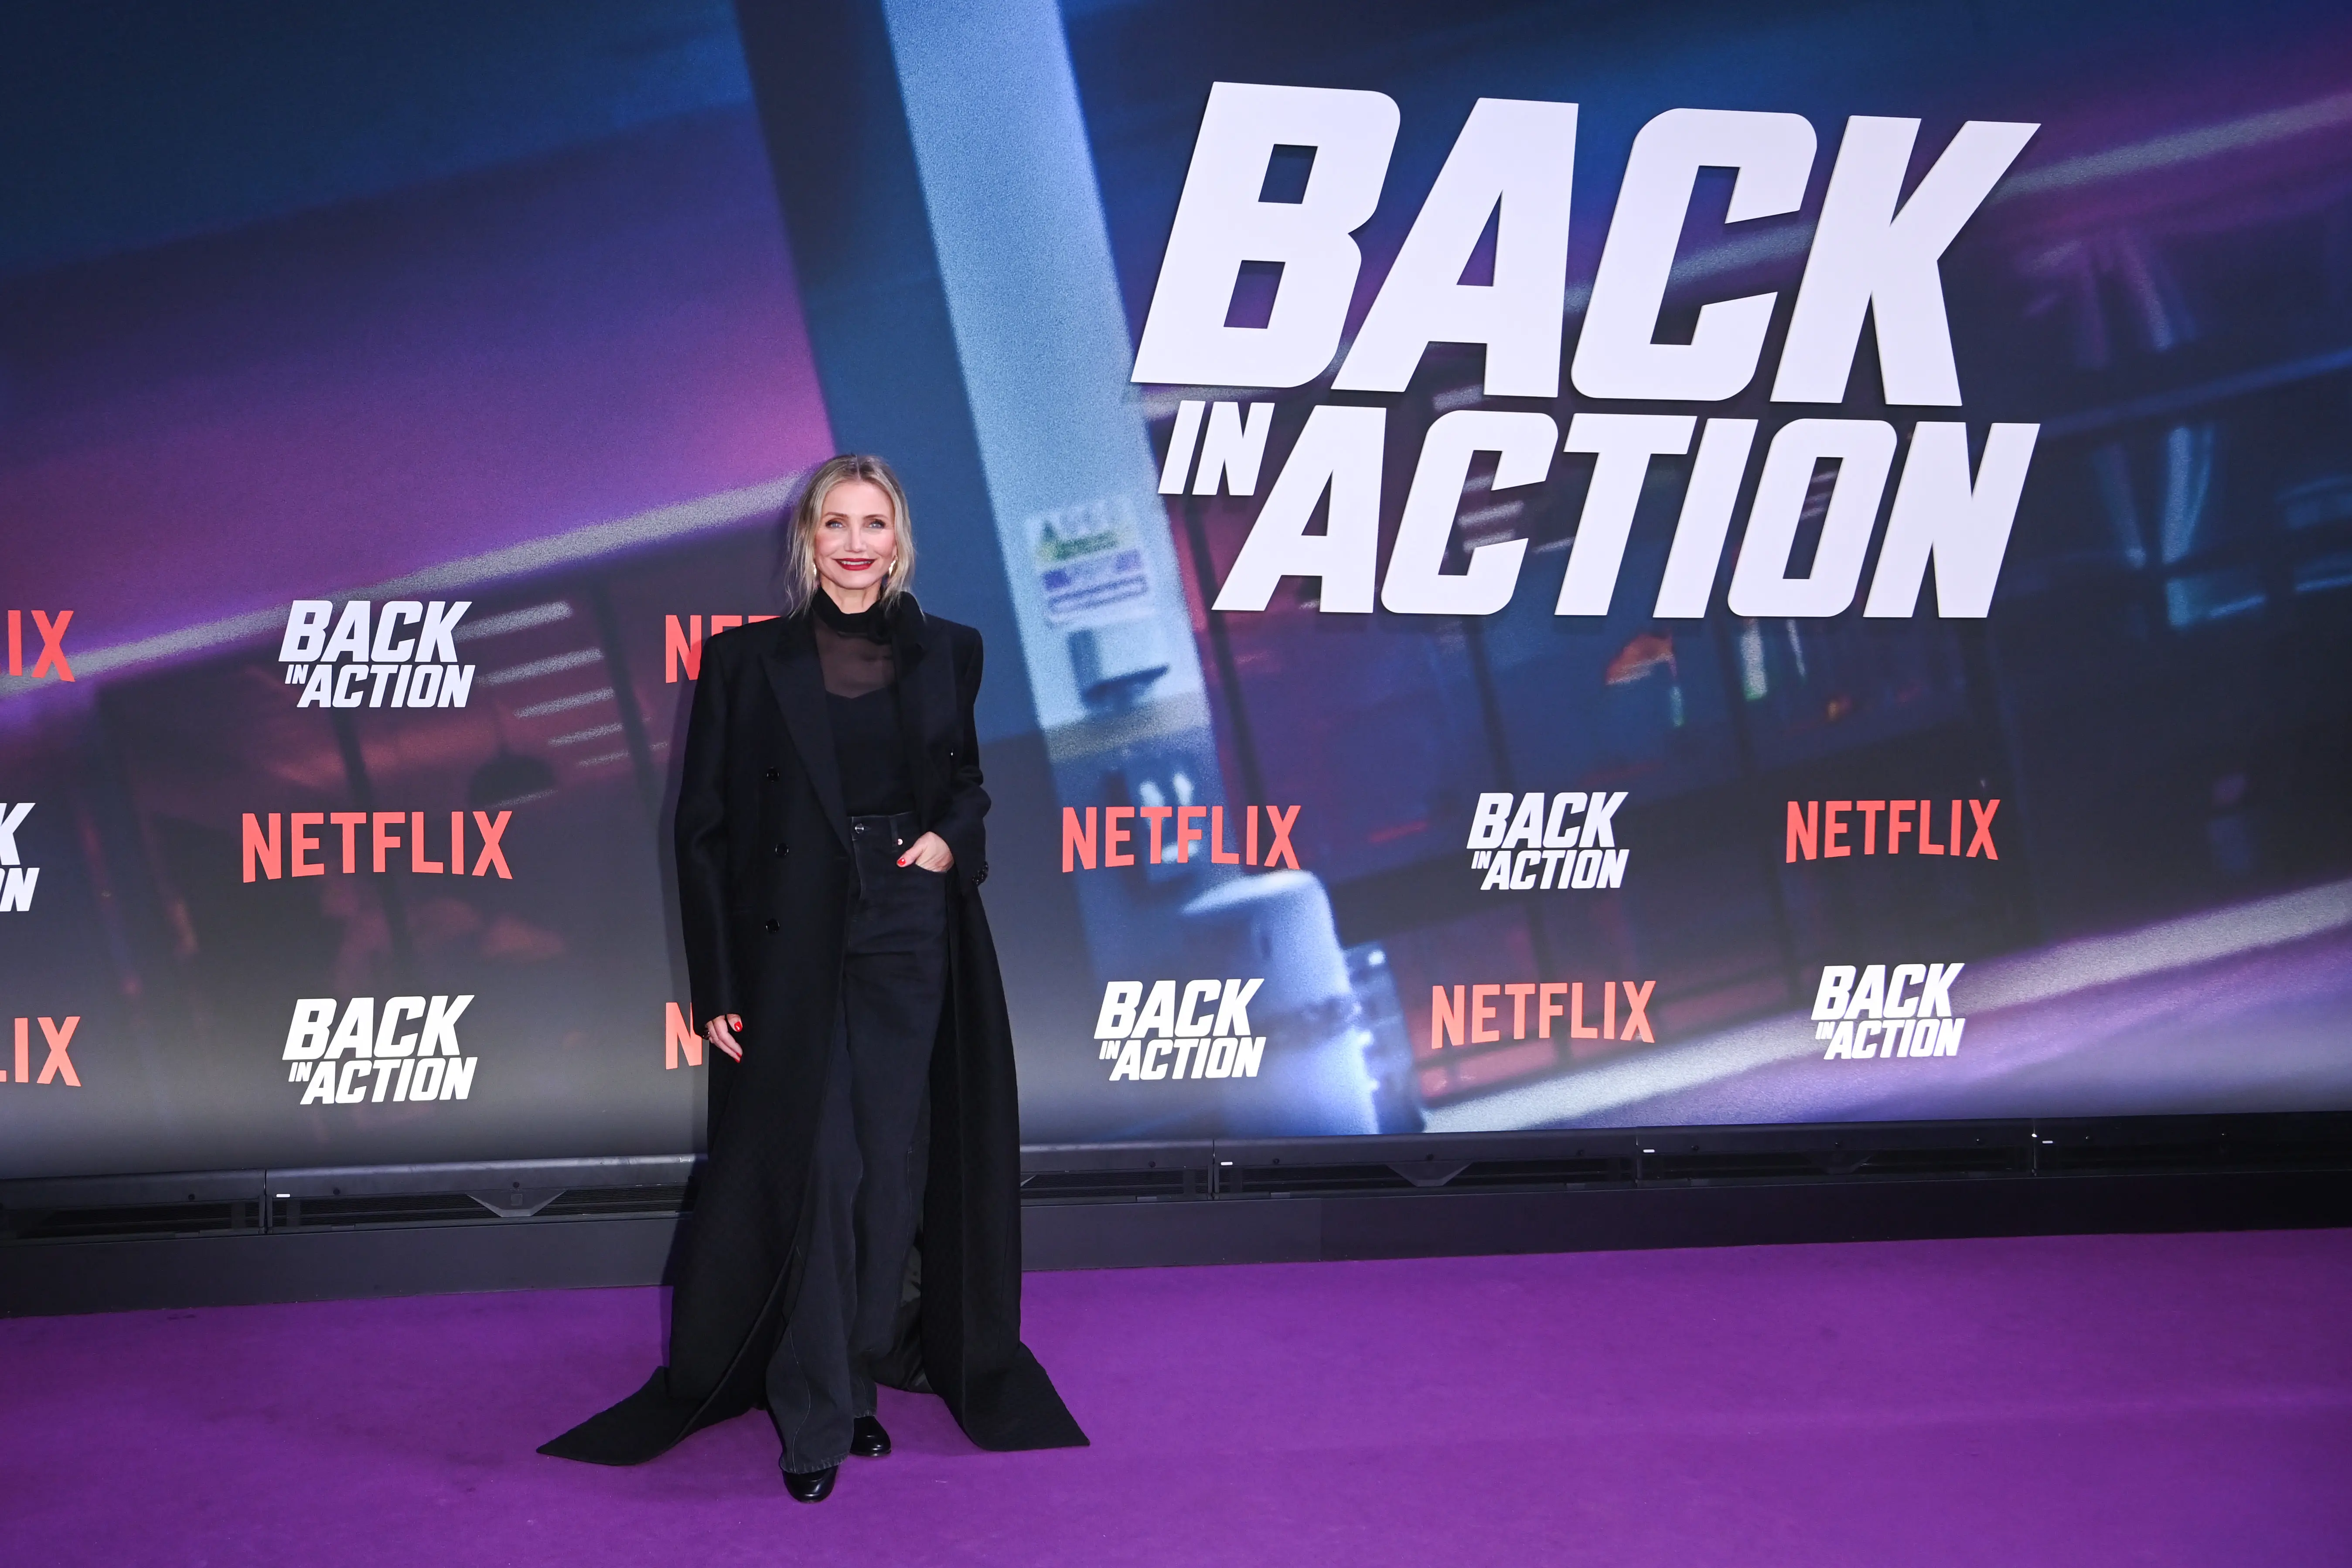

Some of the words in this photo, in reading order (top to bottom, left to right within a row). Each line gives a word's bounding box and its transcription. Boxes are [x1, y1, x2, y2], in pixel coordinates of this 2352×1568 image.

[1131, 82, 2041, 406] BACK
[1158, 400, 1275, 496] IN
[1212, 405, 2040, 618] ACTION
[0, 610, 75, 682] IX
[279, 600, 472, 662] BACK
[285, 665, 309, 684] IN
[297, 665, 475, 708] ACTION
[242, 811, 513, 883] NETFLIX
[1062, 805, 1301, 873] NETFLIX
[1466, 792, 1628, 849] BACK
[1786, 799, 2000, 863] NETFLIX
[1471, 851, 1492, 869] IN
[1480, 849, 1629, 890] ACTION
[0, 867, 40, 912] N
[1094, 978, 1265, 1039] BACK
[1432, 980, 1656, 1050] NETFLIX
[1810, 963, 1965, 1020] BACK
[282, 995, 475, 1060] BACK
[1099, 1040, 1121, 1060] IN
[1815, 1021, 1835, 1040] IN
[1823, 1018, 1965, 1060] ACTION
[288, 1061, 313, 1082] IN
[300, 1057, 478, 1104] ACTION
[1109, 1036, 1266, 1081] ACTION
